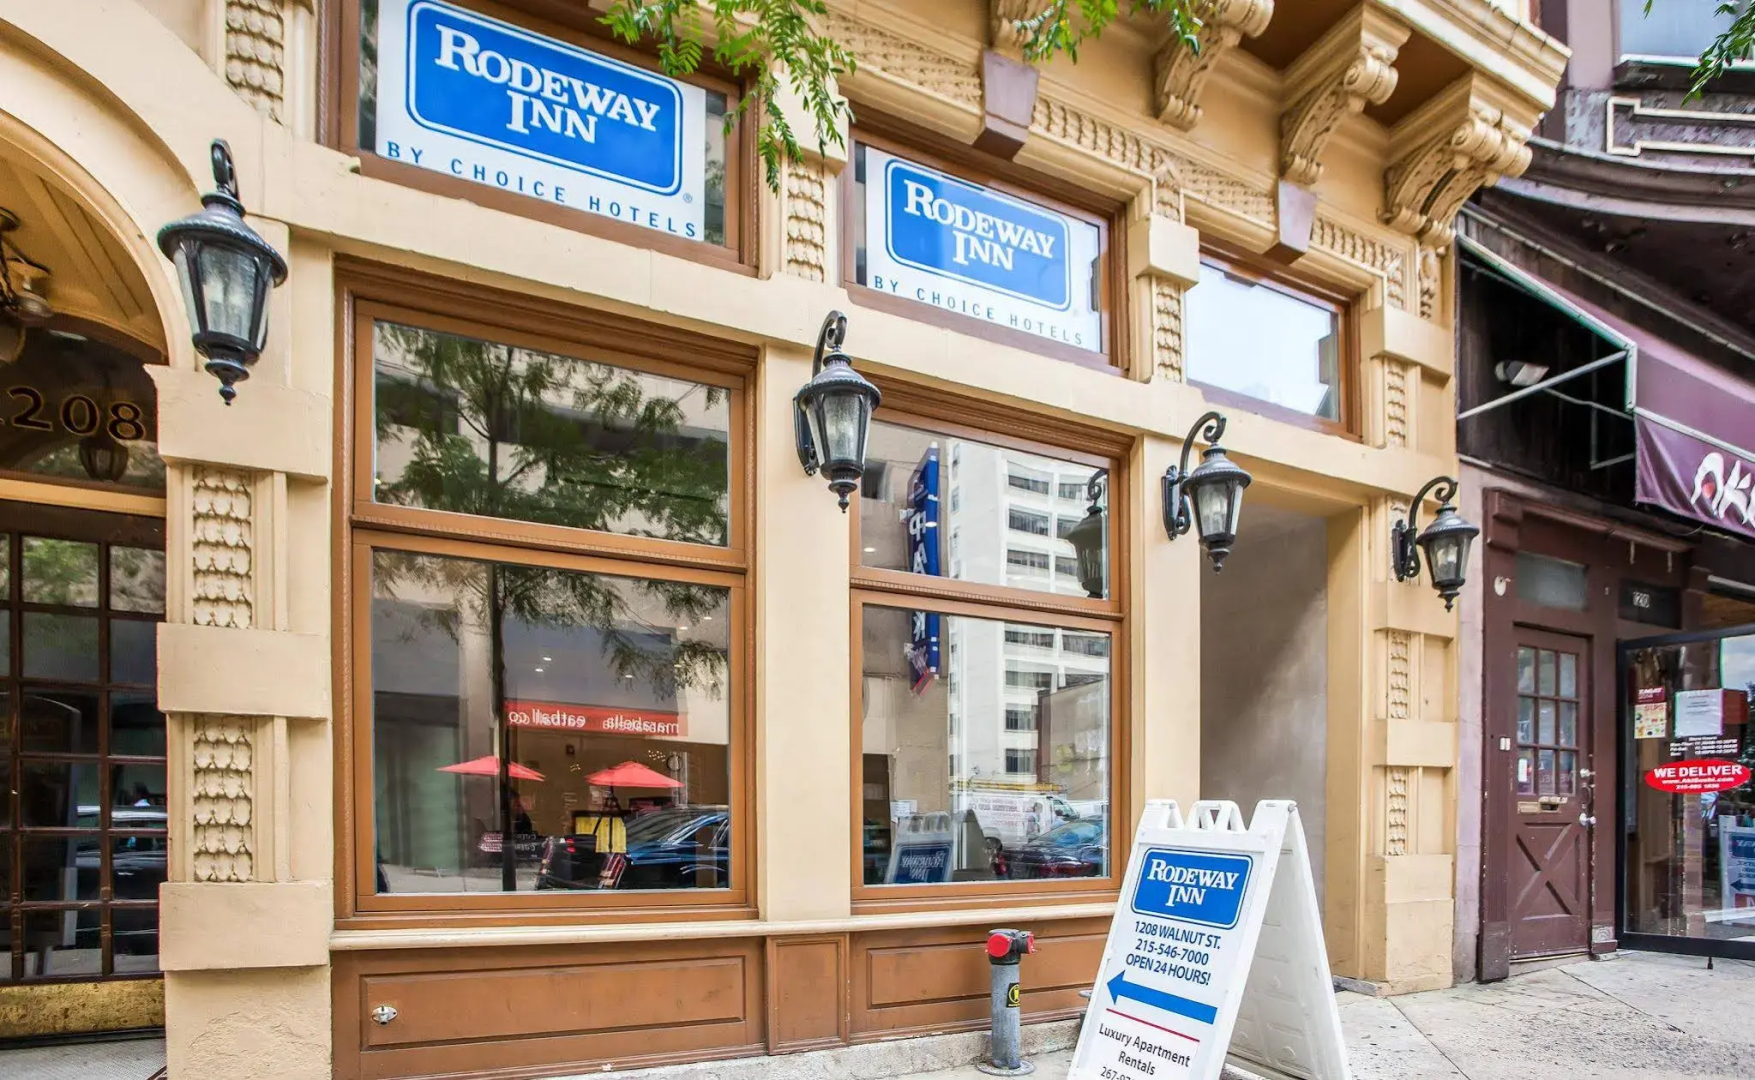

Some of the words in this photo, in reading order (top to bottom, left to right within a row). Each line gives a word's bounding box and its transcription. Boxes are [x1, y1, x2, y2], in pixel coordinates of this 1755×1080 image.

[435, 23, 660, 132] RODEWAY
[506, 90, 597, 144] INN
[388, 141, 424, 164] BY
[451, 158, 565, 203] CHOICE
[590, 195, 696, 237] HOTELS
[904, 179, 1055, 258] RODEWAY
[952, 230, 1015, 271] INN
[874, 275, 899, 293] BY
[917, 287, 995, 320] CHOICE
[1010, 314, 1082, 345] HOTELS
[0, 385, 146, 440] 208
[1653, 768, 1676, 779] WE
[1679, 764, 1742, 777] DELIVER
[1147, 859, 1240, 890] RODEWAY
[1166, 884, 1207, 907] INN
[1134, 920, 1157, 936] 1208
[1159, 923, 1206, 946] WALNUT
[1207, 934, 1221, 950] ST.
[1135, 938, 1209, 966] 215-546-7000
[1126, 953, 1153, 972] OPEN
[1154, 960, 1167, 975] 24
[1168, 965, 1211, 985] HOURS!
[1099, 1023, 1132, 1048] Luxury
[1133, 1035, 1191, 1068] Apartment
[1118, 1051, 1155, 1076] Rentals
